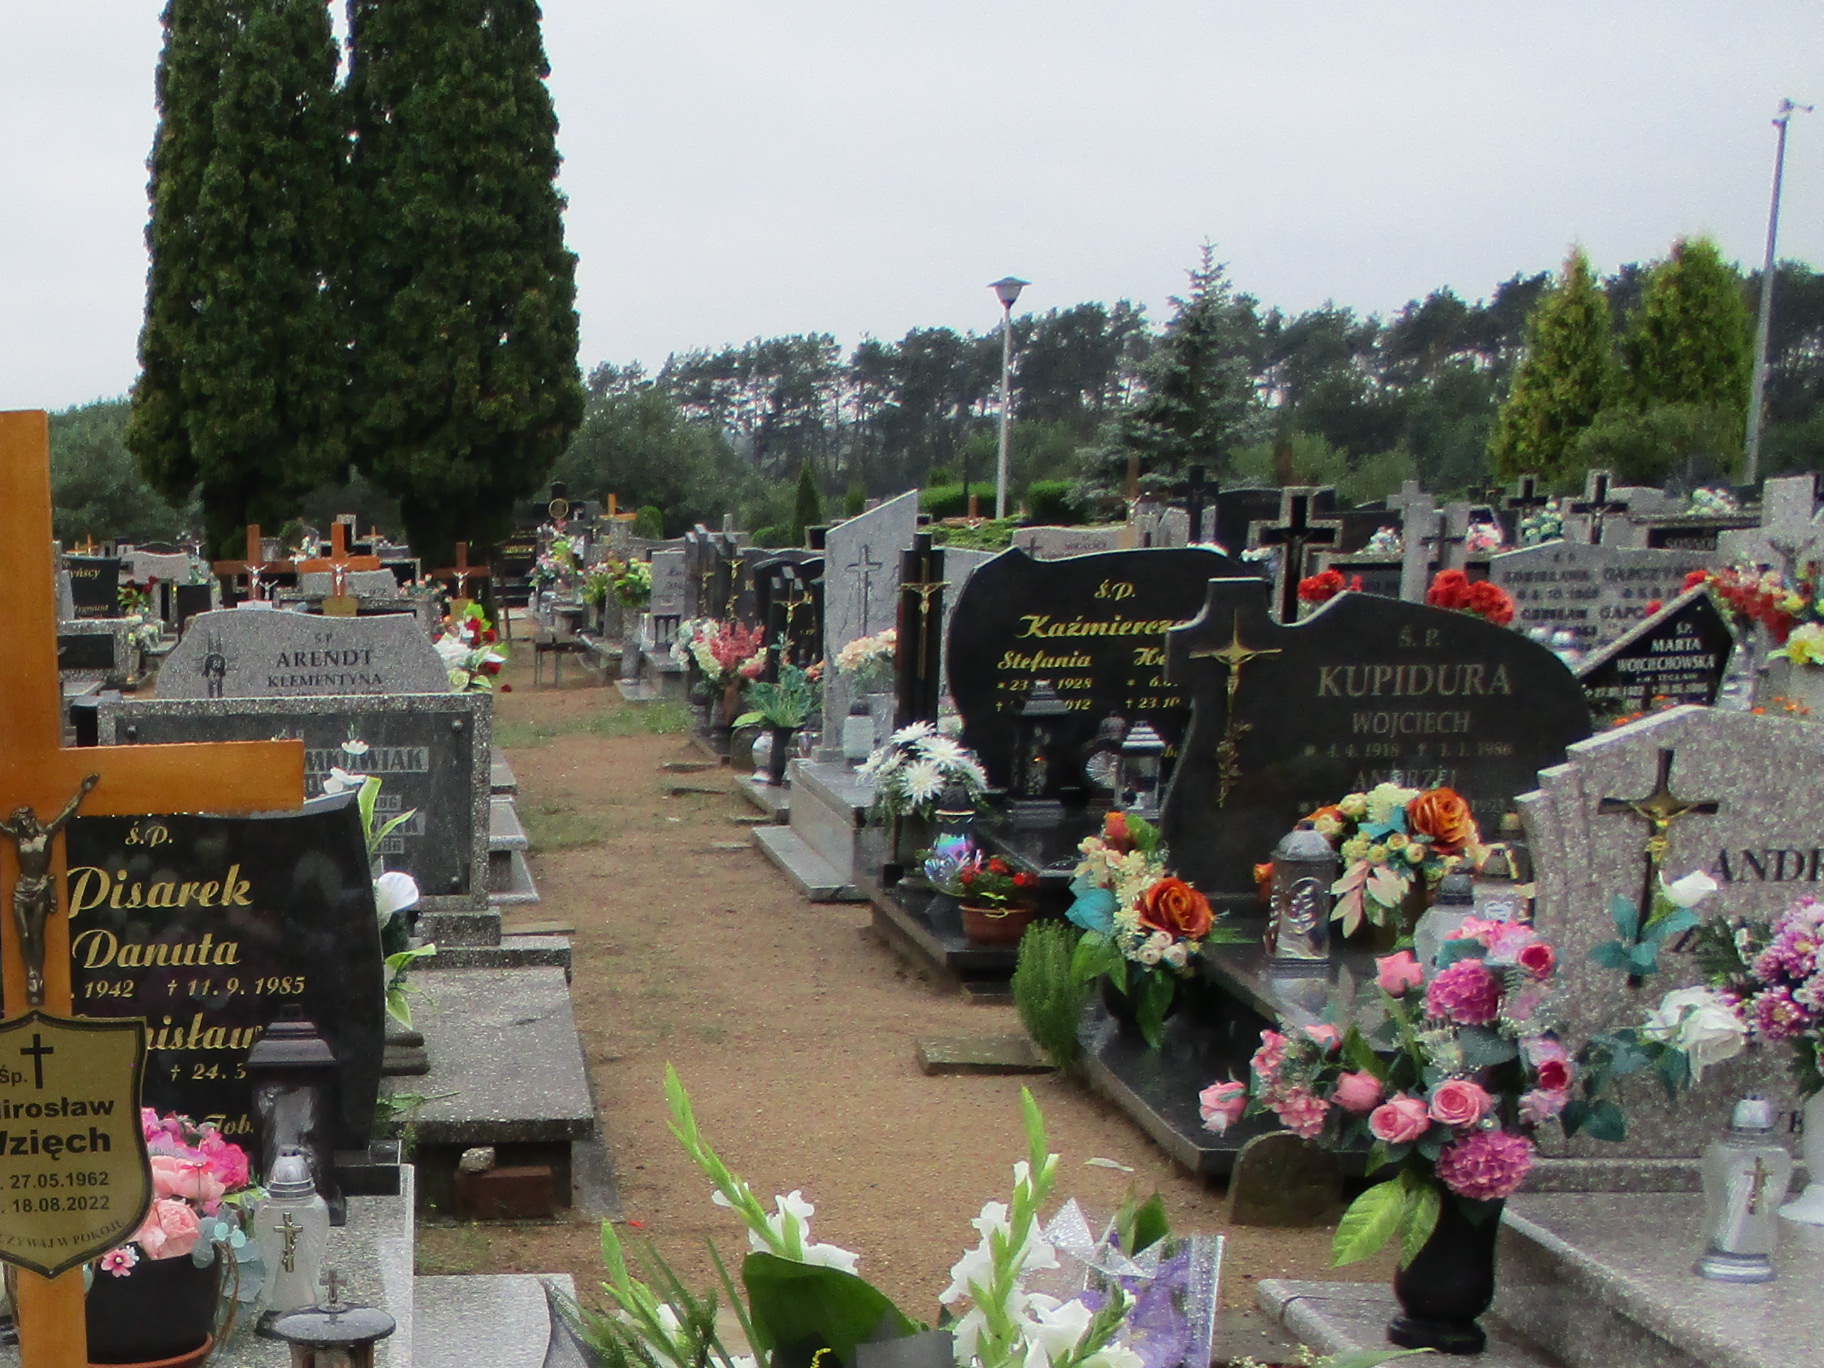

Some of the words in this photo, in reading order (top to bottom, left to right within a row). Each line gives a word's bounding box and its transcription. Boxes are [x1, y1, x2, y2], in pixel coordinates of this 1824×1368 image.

[276, 648, 373, 669] ARENDT
[996, 651, 1093, 673] Stefania
[267, 671, 383, 689] KLEMENTYNA
[1057, 678, 1094, 691] 1928
[1317, 662, 1513, 698] KUPIDURA
[1350, 711, 1472, 738] WOJCIECH
[66, 863, 254, 919] Pisarek
[71, 928, 242, 969] Danuta
[84, 978, 135, 999] 1942
[255, 975, 307, 995] 1985
[9, 1171, 110, 1189] 27.05.1962
[12, 1195, 110, 1214] 18.08.2022
